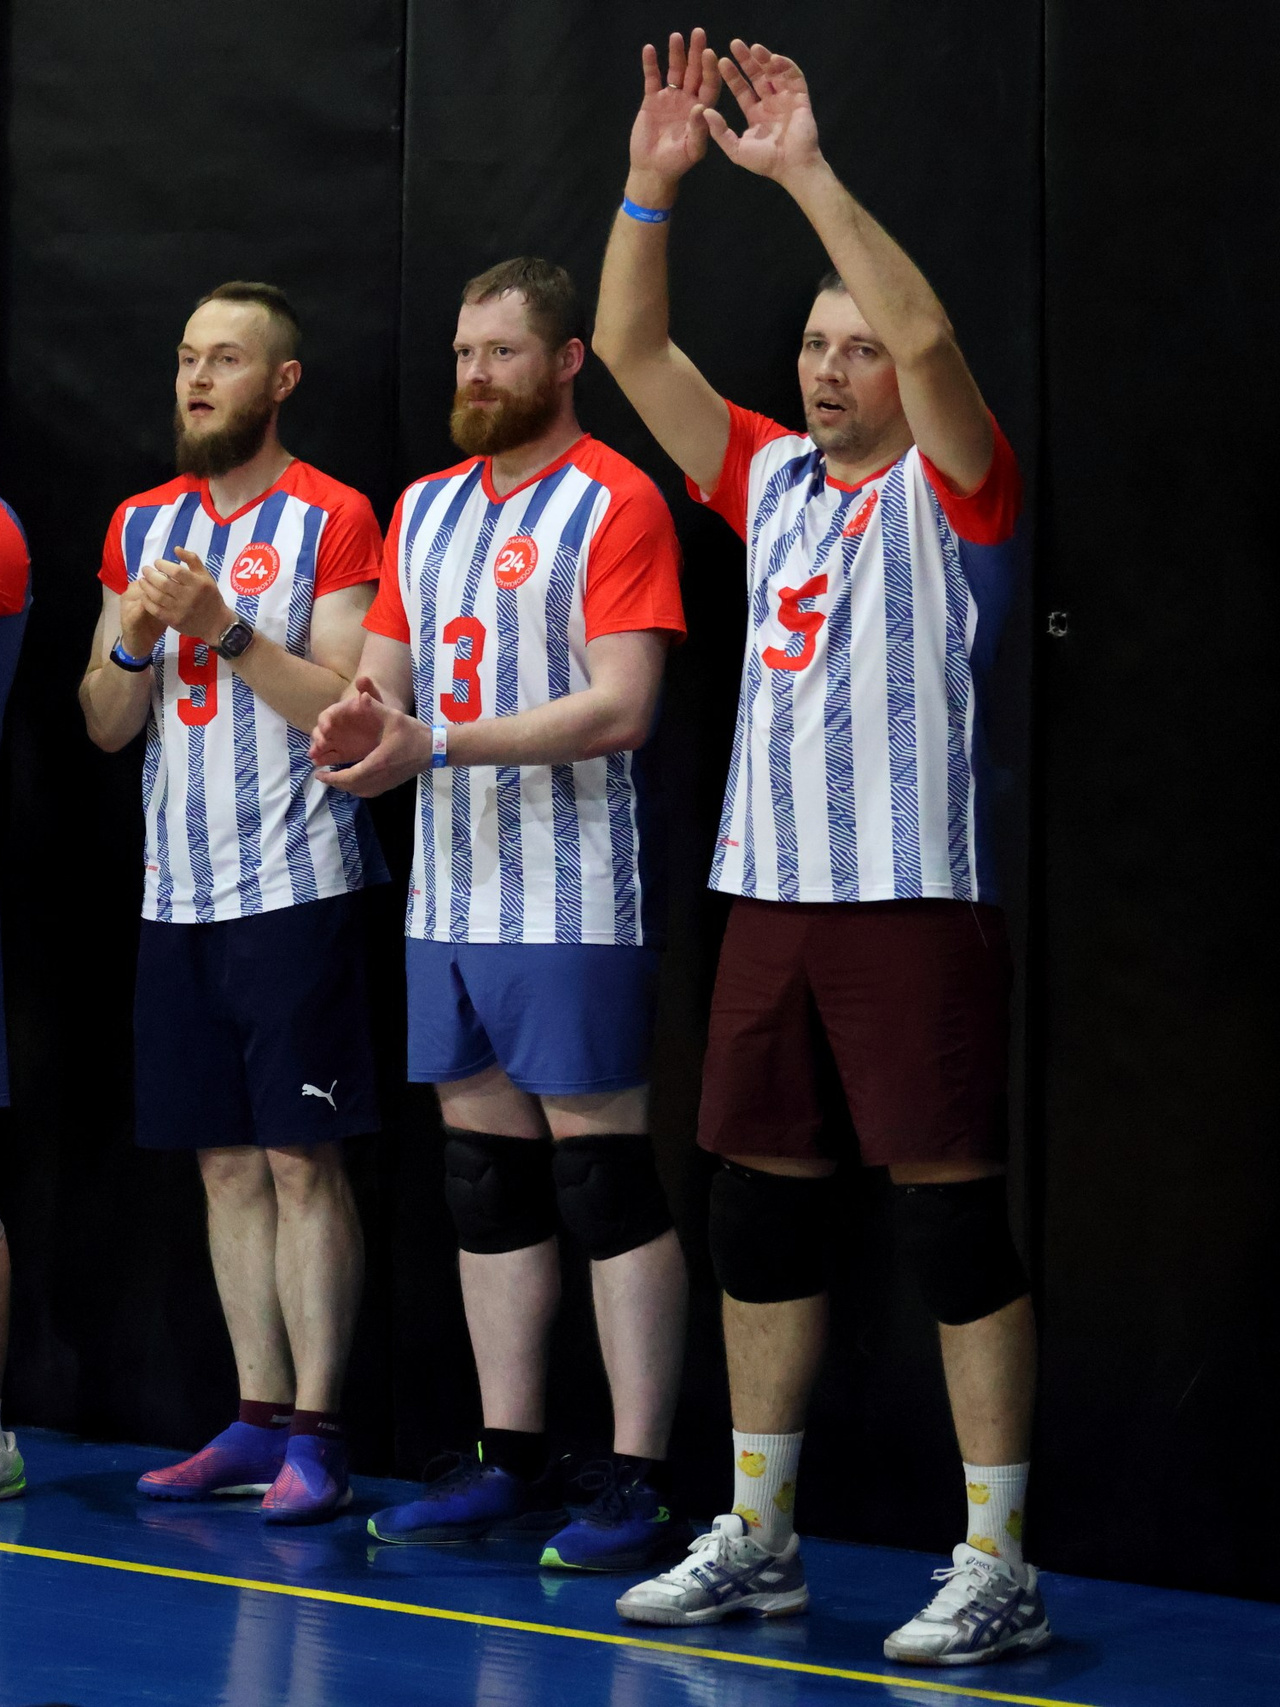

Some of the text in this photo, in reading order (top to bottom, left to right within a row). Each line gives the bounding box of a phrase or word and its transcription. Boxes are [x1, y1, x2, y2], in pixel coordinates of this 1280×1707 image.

[236, 557, 269, 580] 24
[498, 549, 525, 573] 24
[761, 573, 828, 672] 5
[177, 633, 218, 726] 9
[440, 616, 487, 723] 3
